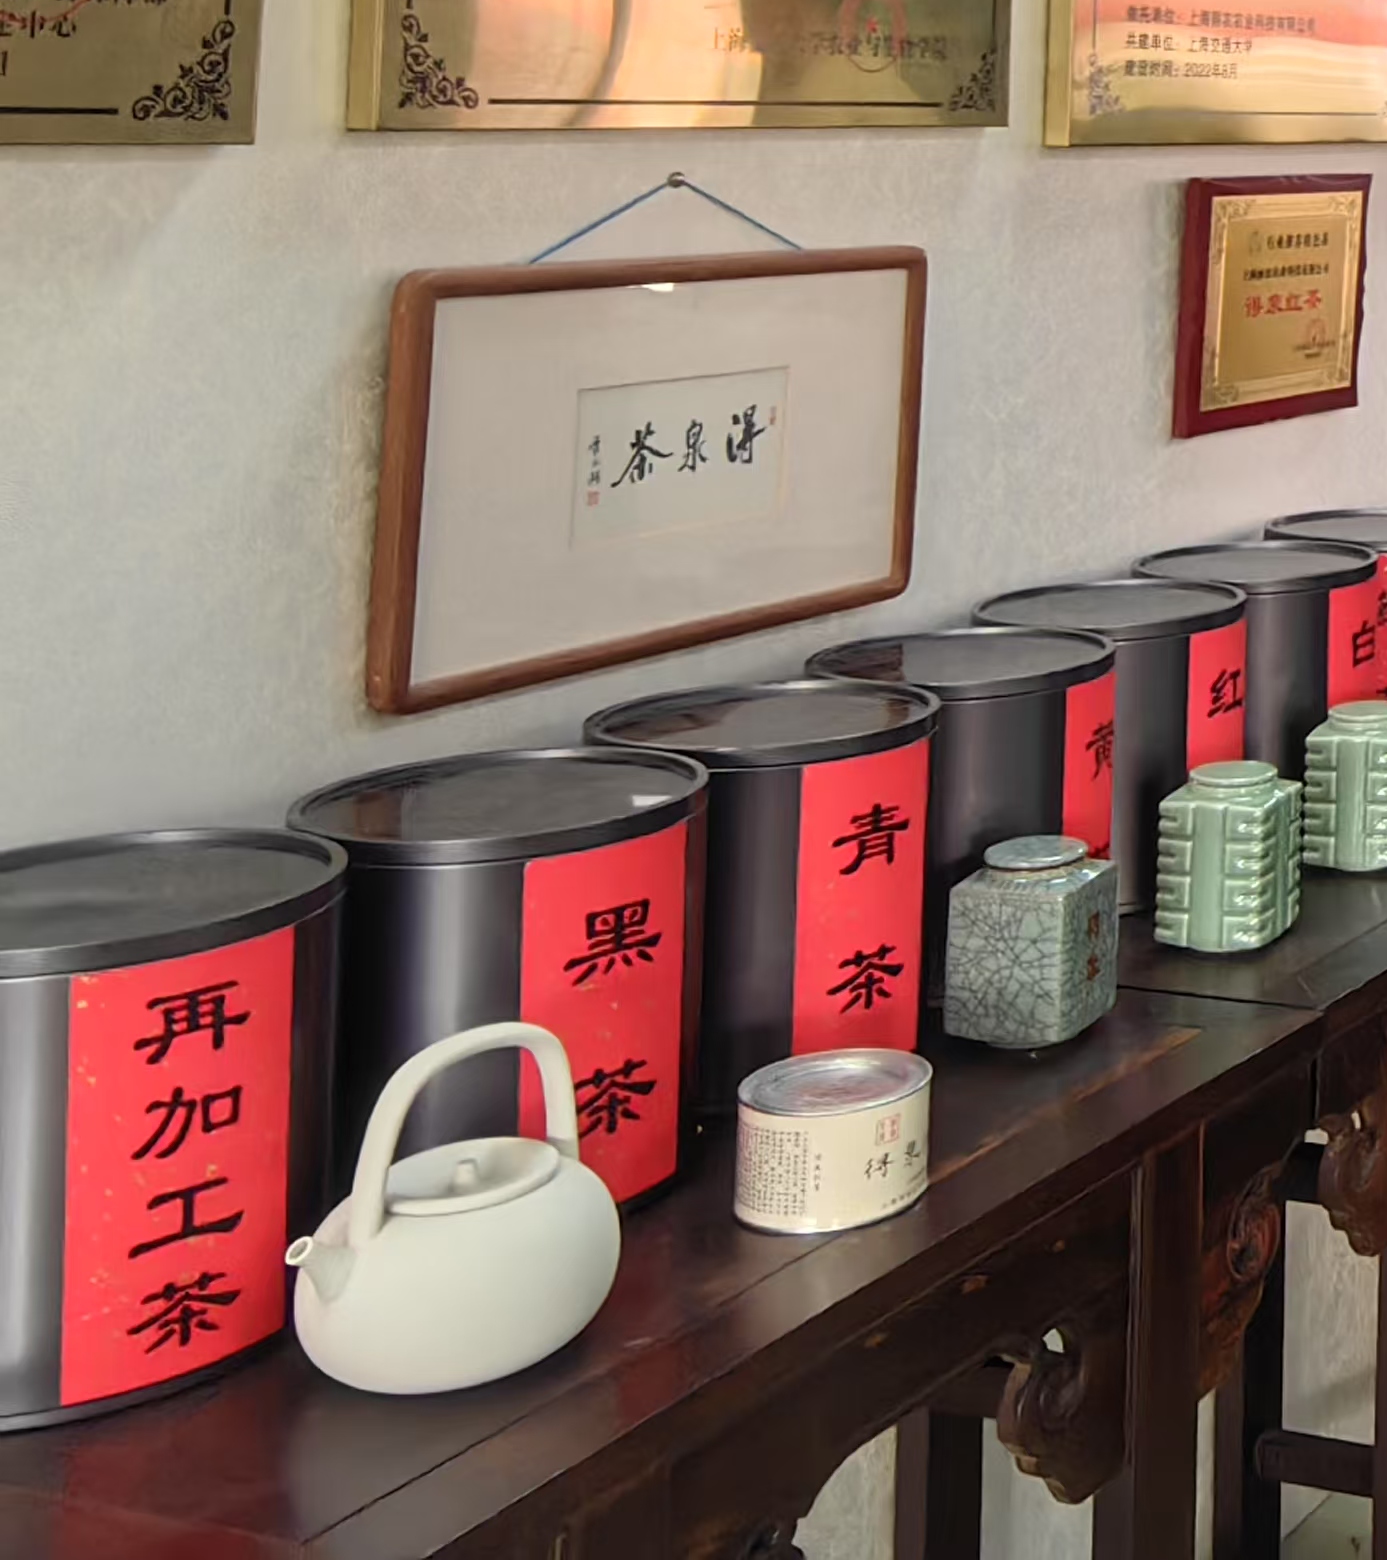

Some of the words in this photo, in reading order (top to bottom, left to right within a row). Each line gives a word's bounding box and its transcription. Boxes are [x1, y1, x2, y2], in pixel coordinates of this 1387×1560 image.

[563, 897, 663, 1142] 黑茶
[826, 803, 910, 1014] 青茶
[128, 979, 251, 1355] 再加工茶
